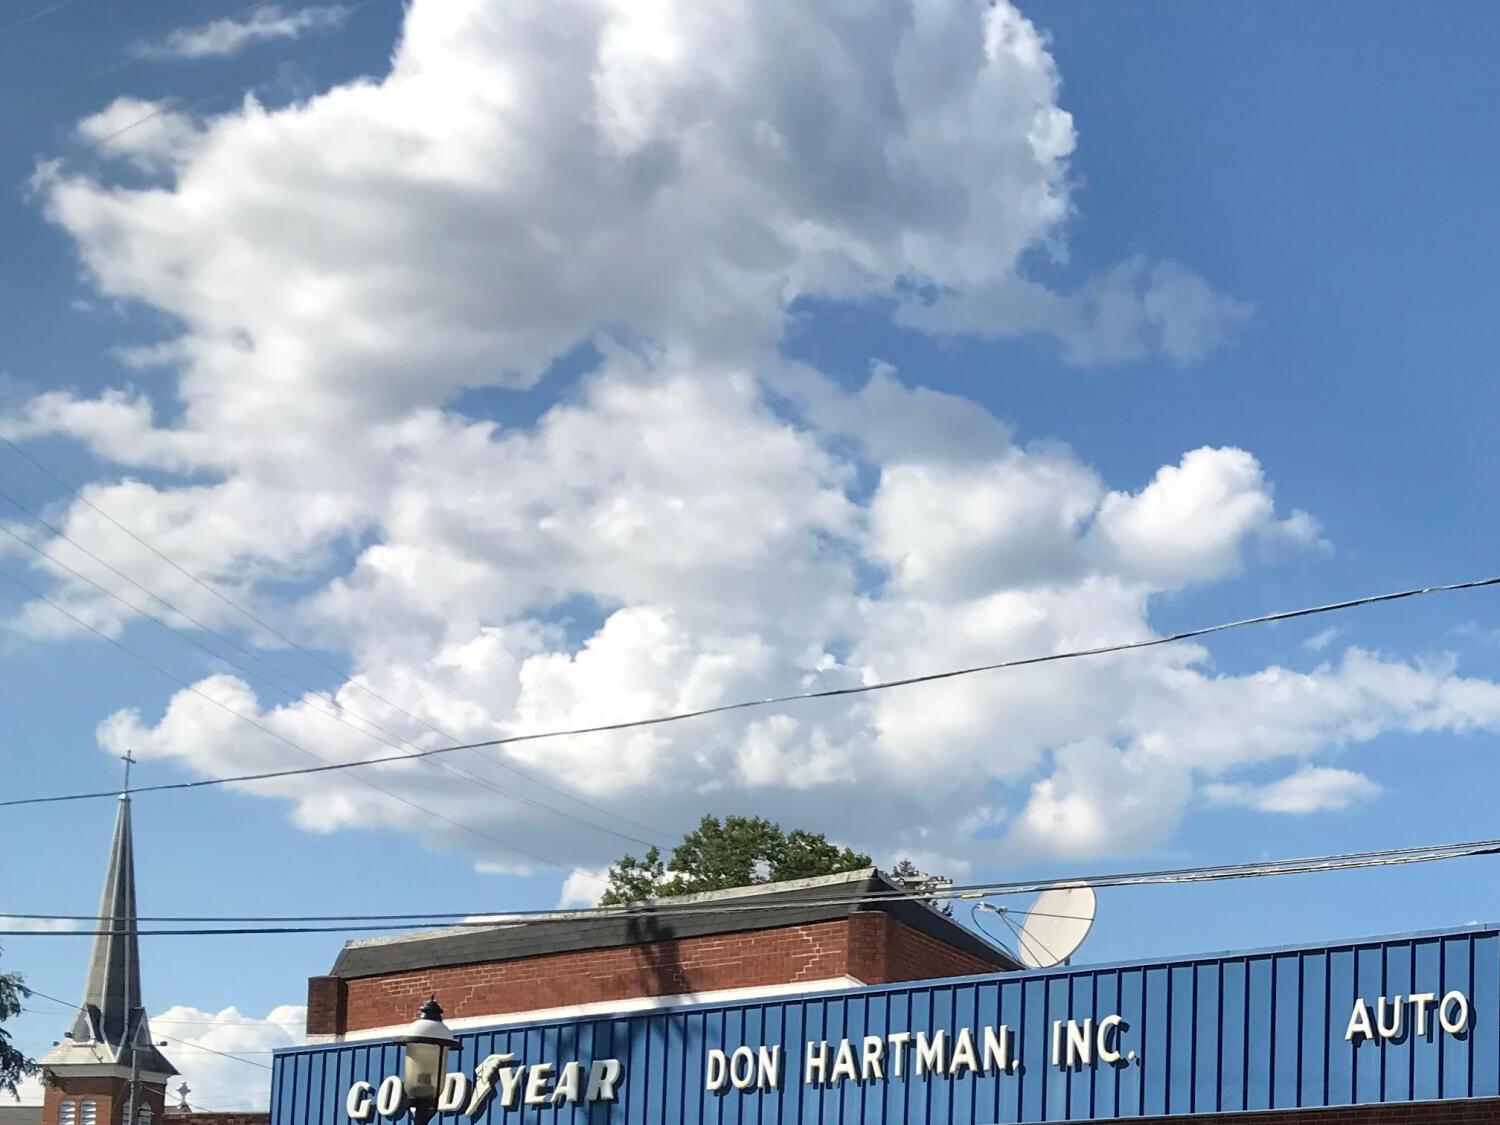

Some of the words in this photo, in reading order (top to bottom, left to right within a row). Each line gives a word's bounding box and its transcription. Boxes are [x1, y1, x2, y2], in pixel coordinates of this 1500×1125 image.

[1345, 990, 1469, 1042] AUTO
[706, 1044, 781, 1091] DON
[1052, 1014, 1137, 1067] INC.
[346, 1058, 622, 1119] GODYEAR
